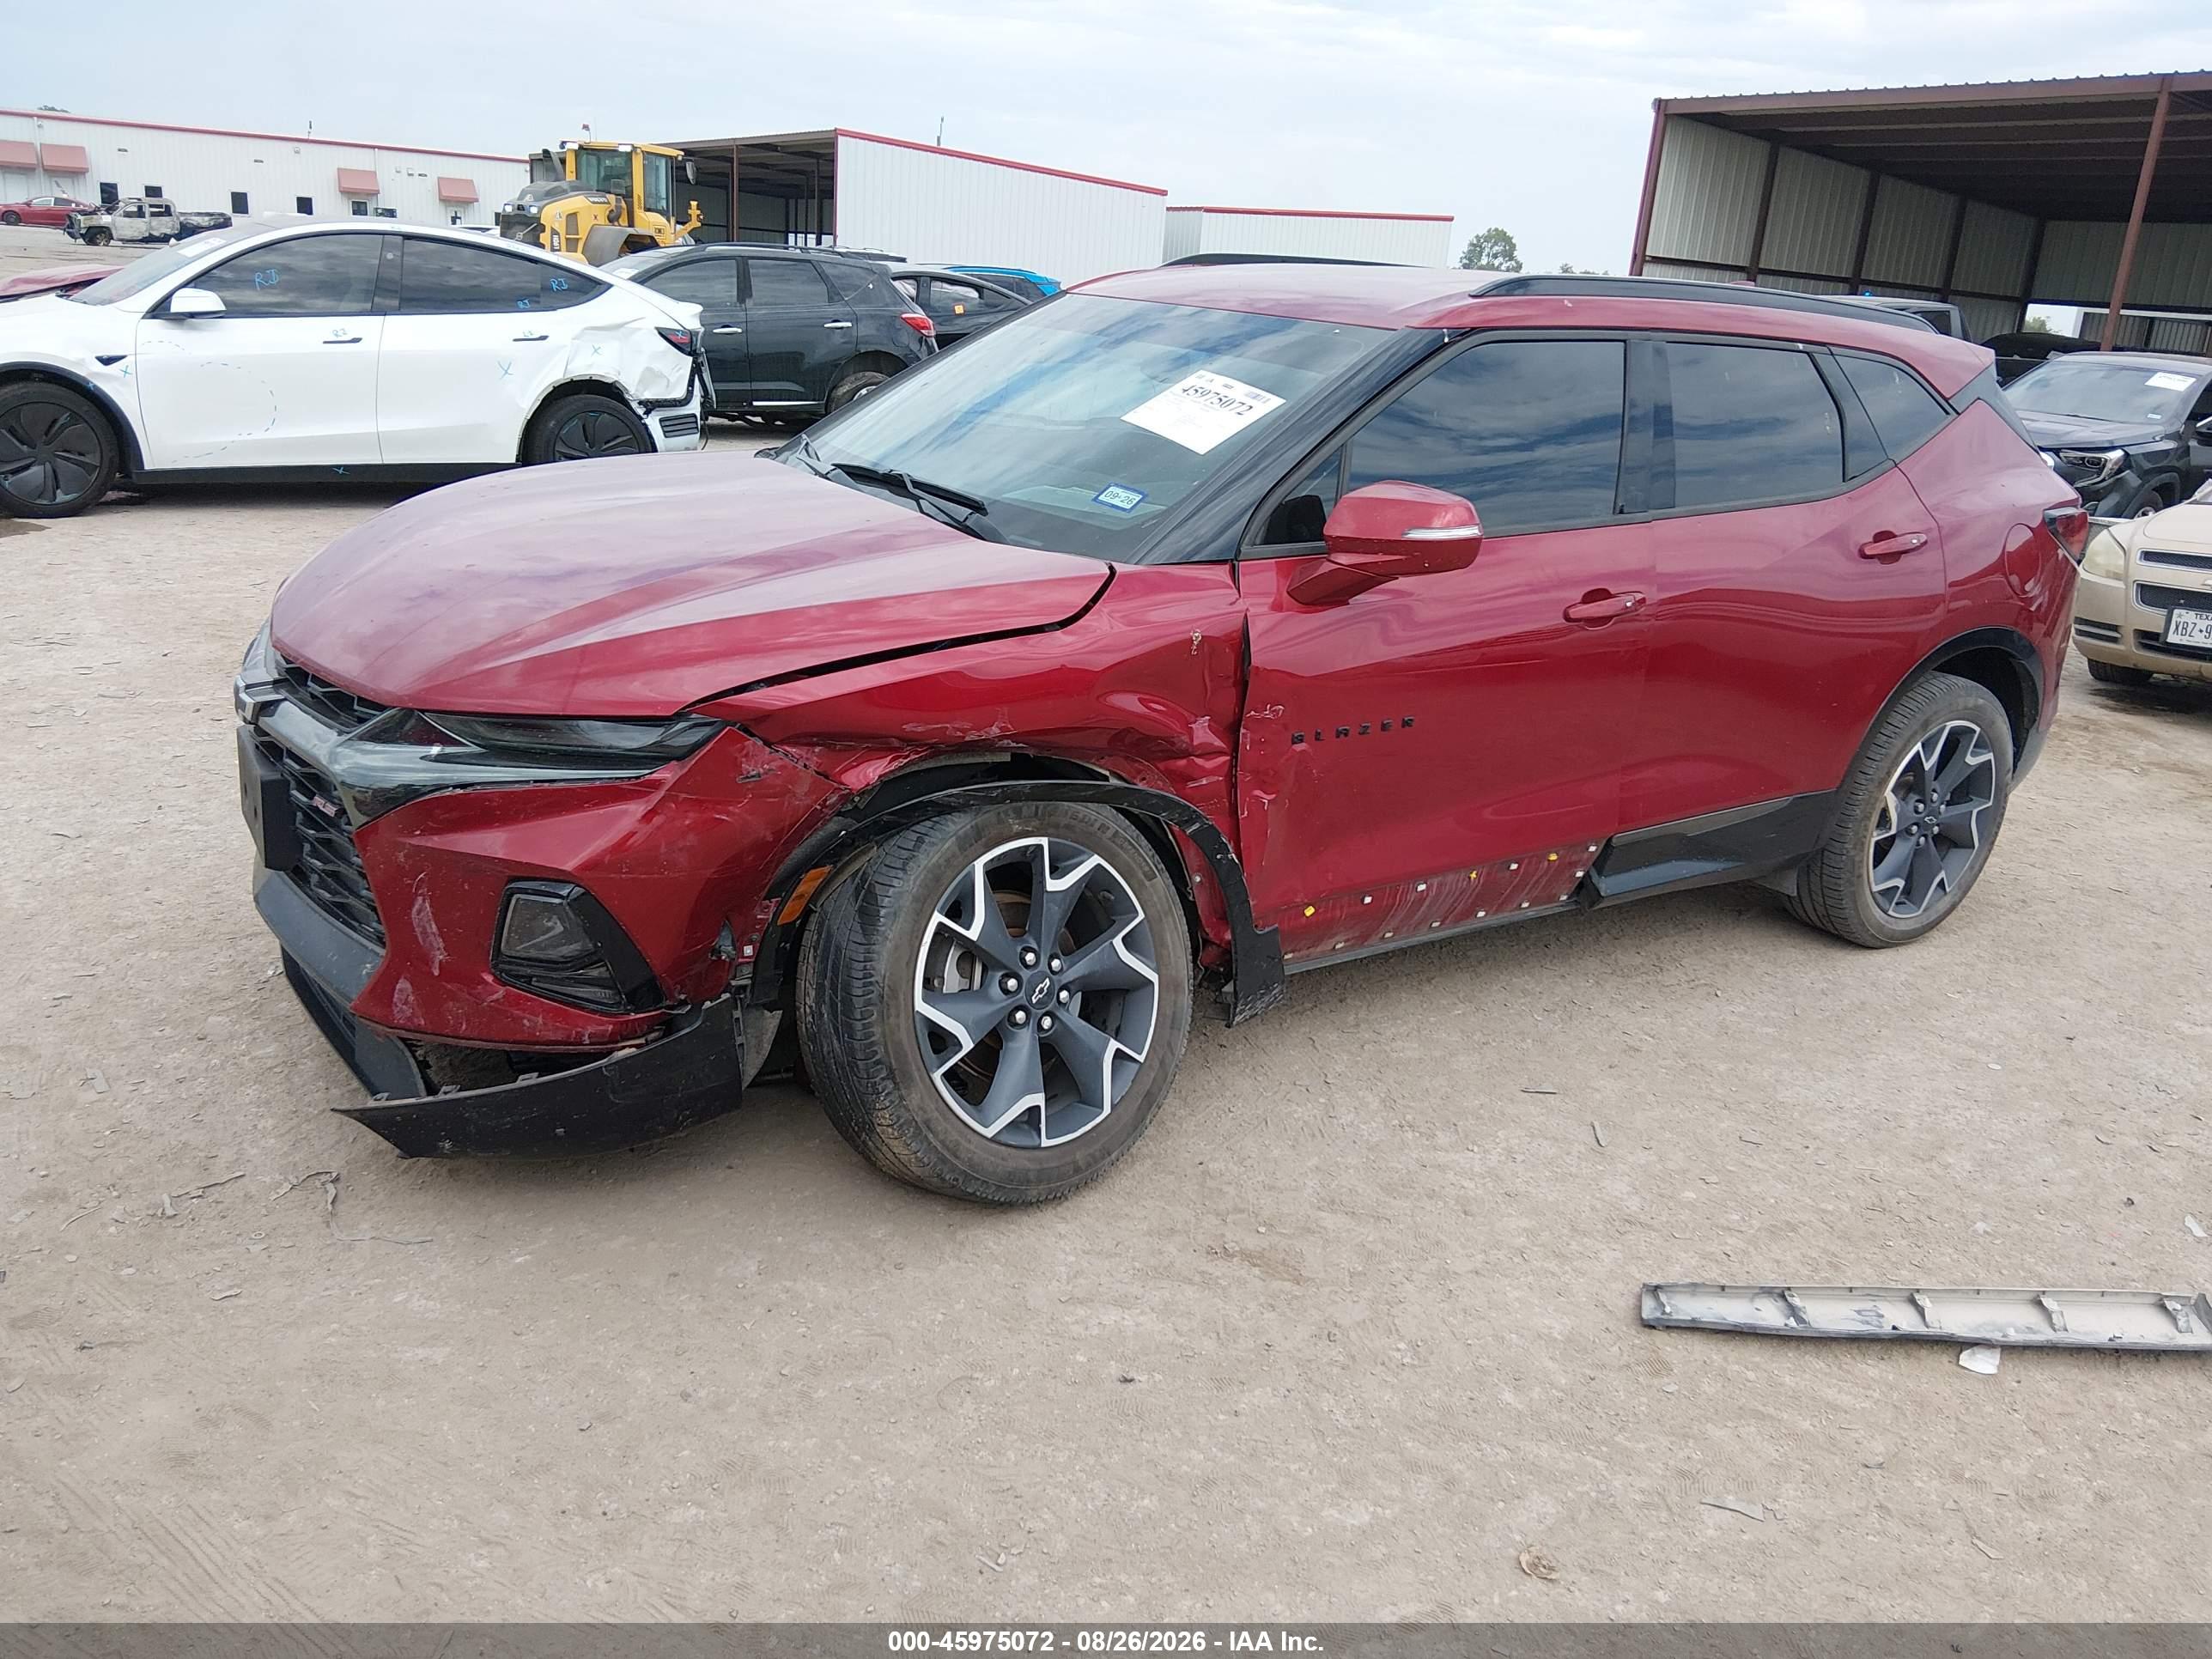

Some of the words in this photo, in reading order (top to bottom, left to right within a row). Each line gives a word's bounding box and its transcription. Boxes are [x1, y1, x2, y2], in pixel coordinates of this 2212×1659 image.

[1182, 384, 1254, 416] 45975072
[2195, 612, 2212, 621] TEX
[1291, 716, 1415, 744] BLAZER
